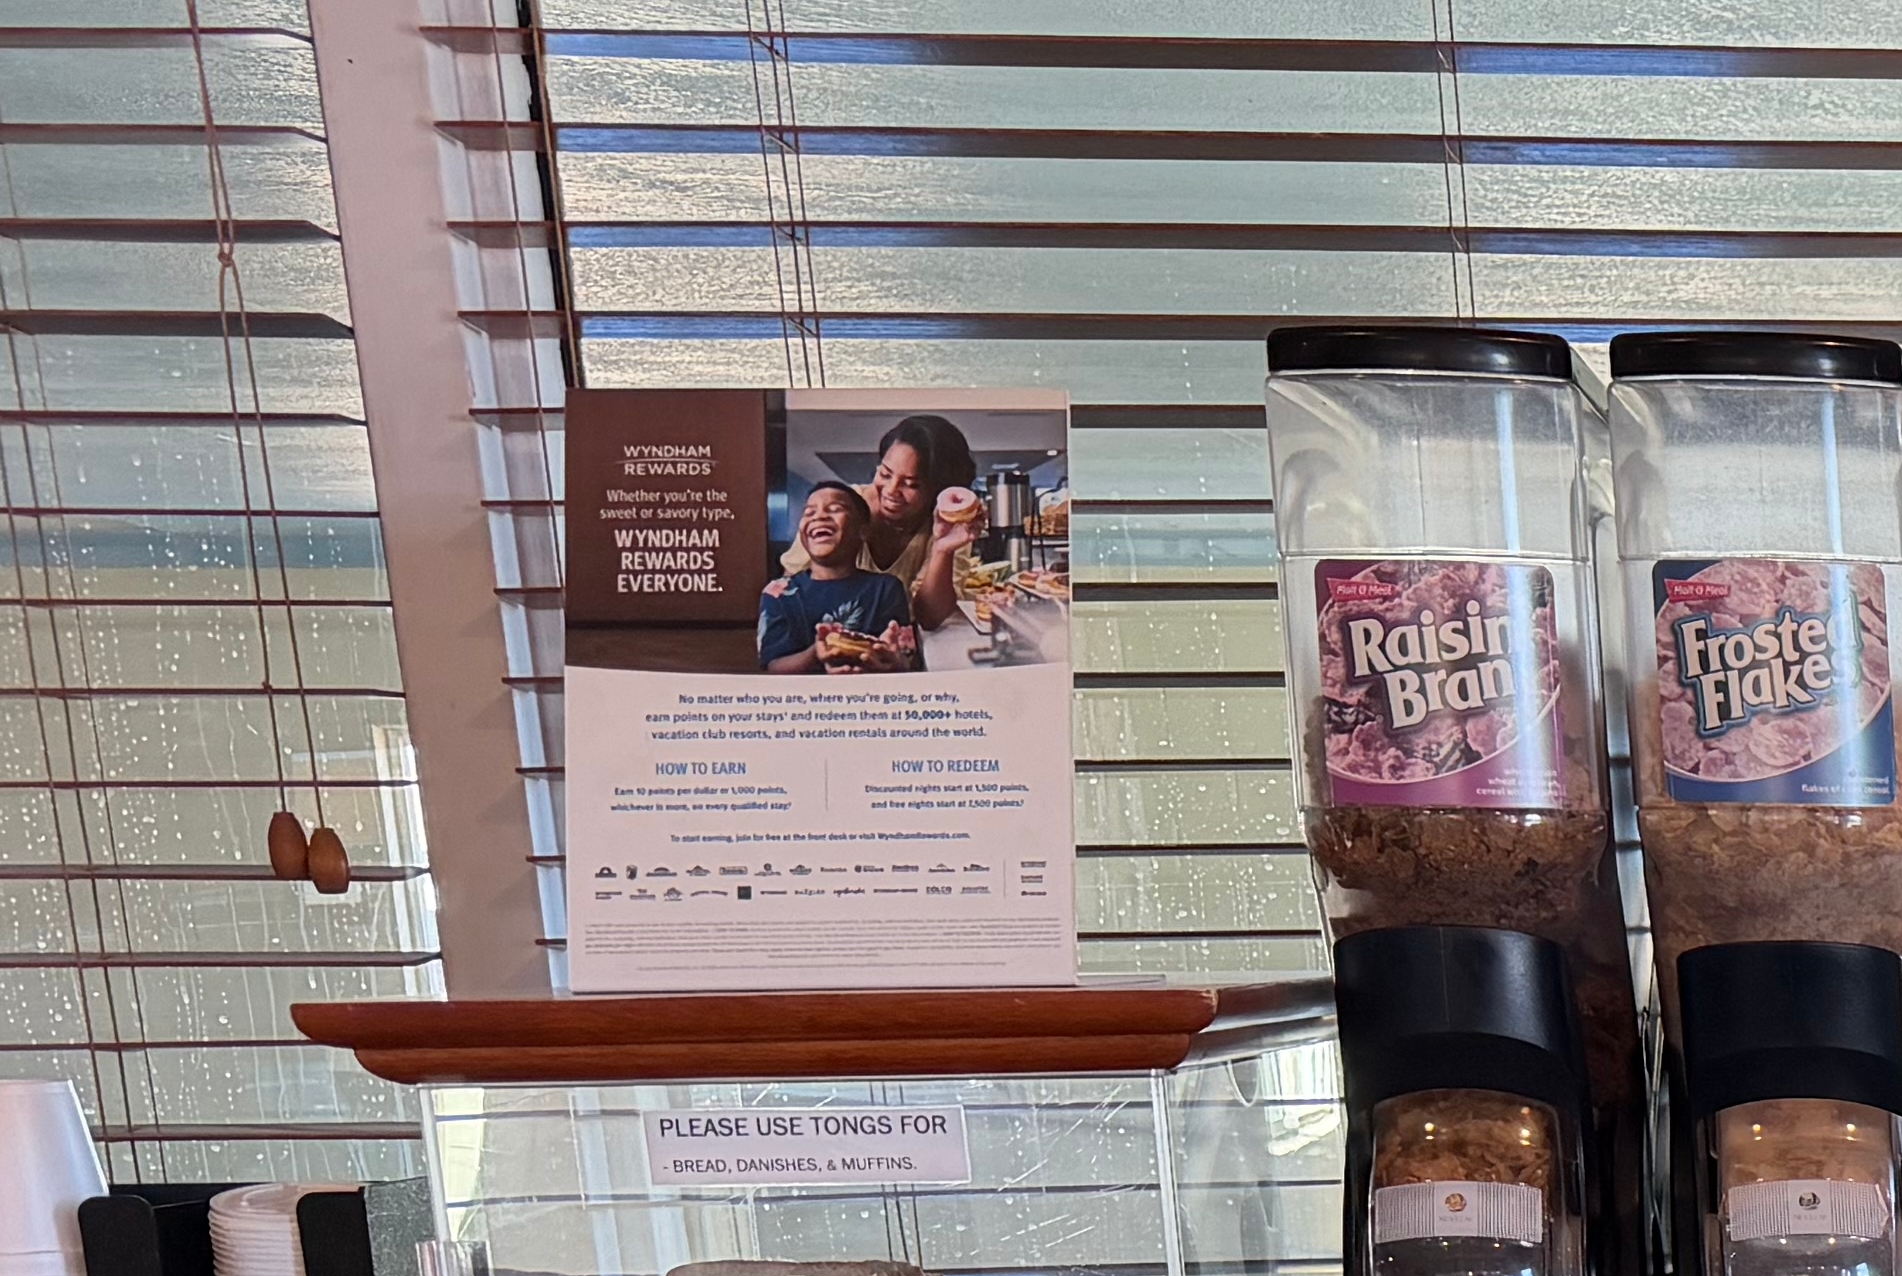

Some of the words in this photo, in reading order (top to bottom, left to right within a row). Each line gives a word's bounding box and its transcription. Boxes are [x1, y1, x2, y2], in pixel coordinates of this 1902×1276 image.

[623, 445, 712, 457] WYNDHAM
[623, 463, 712, 475] REWARDS
[606, 489, 660, 502] Whether
[663, 489, 703, 505] you're
[706, 489, 728, 502] the
[599, 506, 637, 519] sweet
[640, 508, 653, 519] or
[656, 508, 699, 521] savory
[614, 529, 720, 547] WYNDHAM
[621, 551, 715, 570] REWARDS
[617, 573, 723, 592] EVERYONE.
[1348, 599, 1514, 678] Raisin
[1681, 597, 1857, 678] Frosted
[679, 694, 694, 704] No
[697, 694, 733, 704] matter
[736, 693, 760, 704] who
[762, 695, 782, 705] you
[785, 694, 807, 705] are,
[810, 692, 843, 703] where
[846, 692, 880, 704] you're
[921, 693, 932, 702] or
[1383, 658, 1518, 729] Bran
[1700, 650, 1856, 730] Flakes
[645, 713, 670, 722] earn
[673, 711, 708, 724] points
[711, 712, 725, 722] on
[728, 712, 752, 723] your
[791, 711, 812, 721] and
[814, 710, 857, 721] redeem
[859, 709, 888, 720] them
[891, 709, 902, 720] at
[904, 709, 950, 721] 50,000+
[954, 709, 993, 720] hotels,
[651, 729, 699, 740] vacation
[701, 728, 726, 739] club
[729, 729, 771, 740] resorts,
[774, 728, 796, 739] and
[799, 727, 845, 738] vacation
[848, 726, 887, 738] rentals
[889, 726, 928, 738] around
[931, 726, 950, 737] the
[952, 726, 987, 737] world.
[655, 762, 688, 775] HOW
[691, 762, 708, 775] TO
[711, 762, 747, 775] EARN
[892, 760, 924, 773] HOW
[926, 760, 943, 772] TO
[947, 759, 1000, 772] REDEEM
[660, 1117, 749, 1137] PLEASE
[756, 1116, 803, 1136] USE
[810, 1115, 892, 1136] TONGS
[900, 1114, 948, 1135] FOR
[673, 1159, 732, 1174] BREAD,
[737, 1157, 822, 1173] DANISHES,
[827, 1158, 837, 1171] &
[842, 1156, 917, 1171] MUFFINS.
